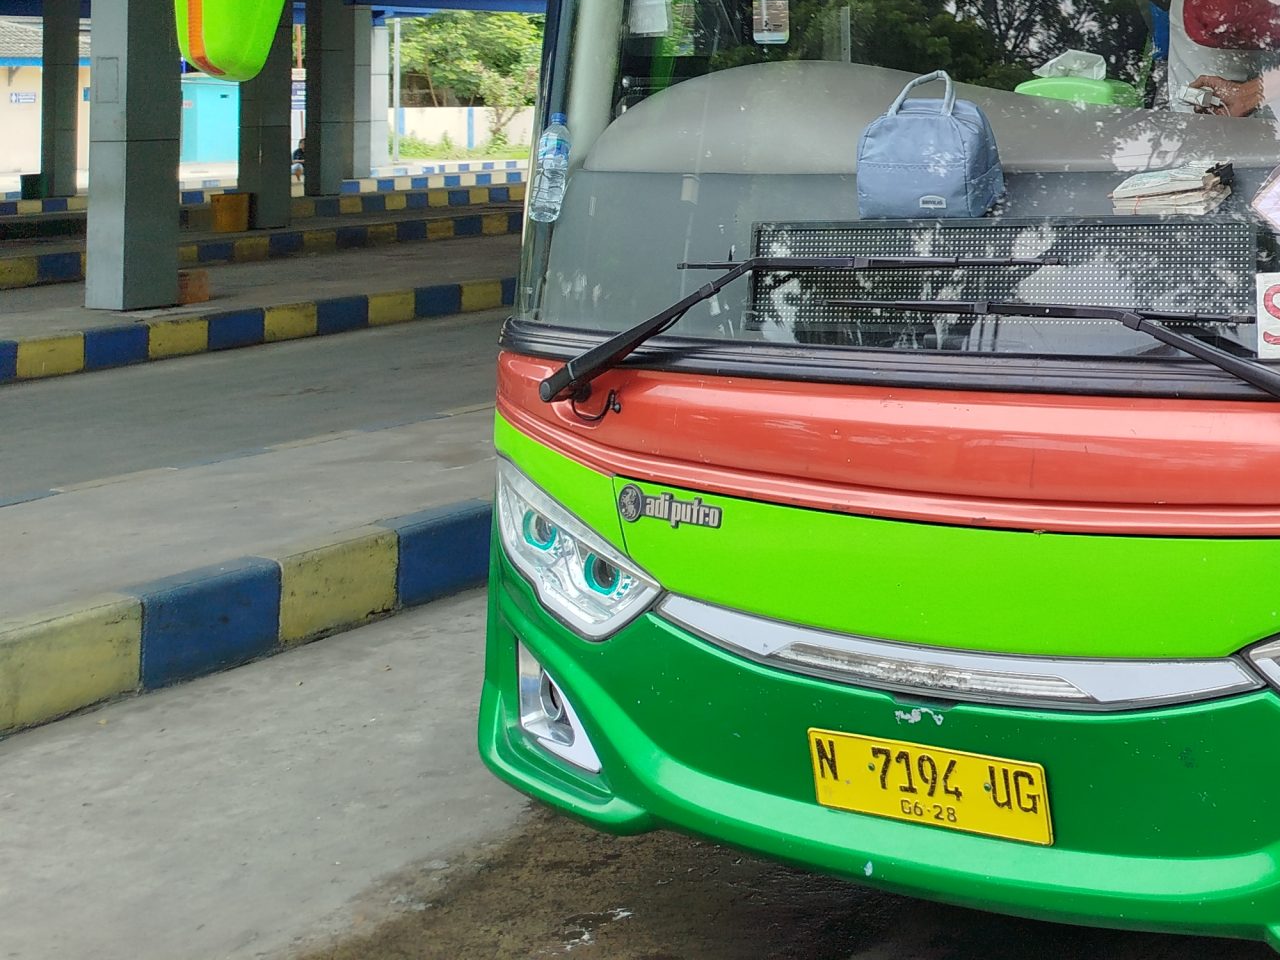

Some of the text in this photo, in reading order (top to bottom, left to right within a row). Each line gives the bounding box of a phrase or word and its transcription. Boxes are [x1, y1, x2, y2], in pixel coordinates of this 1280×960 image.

[814, 737, 1041, 815] N 7194 UG
